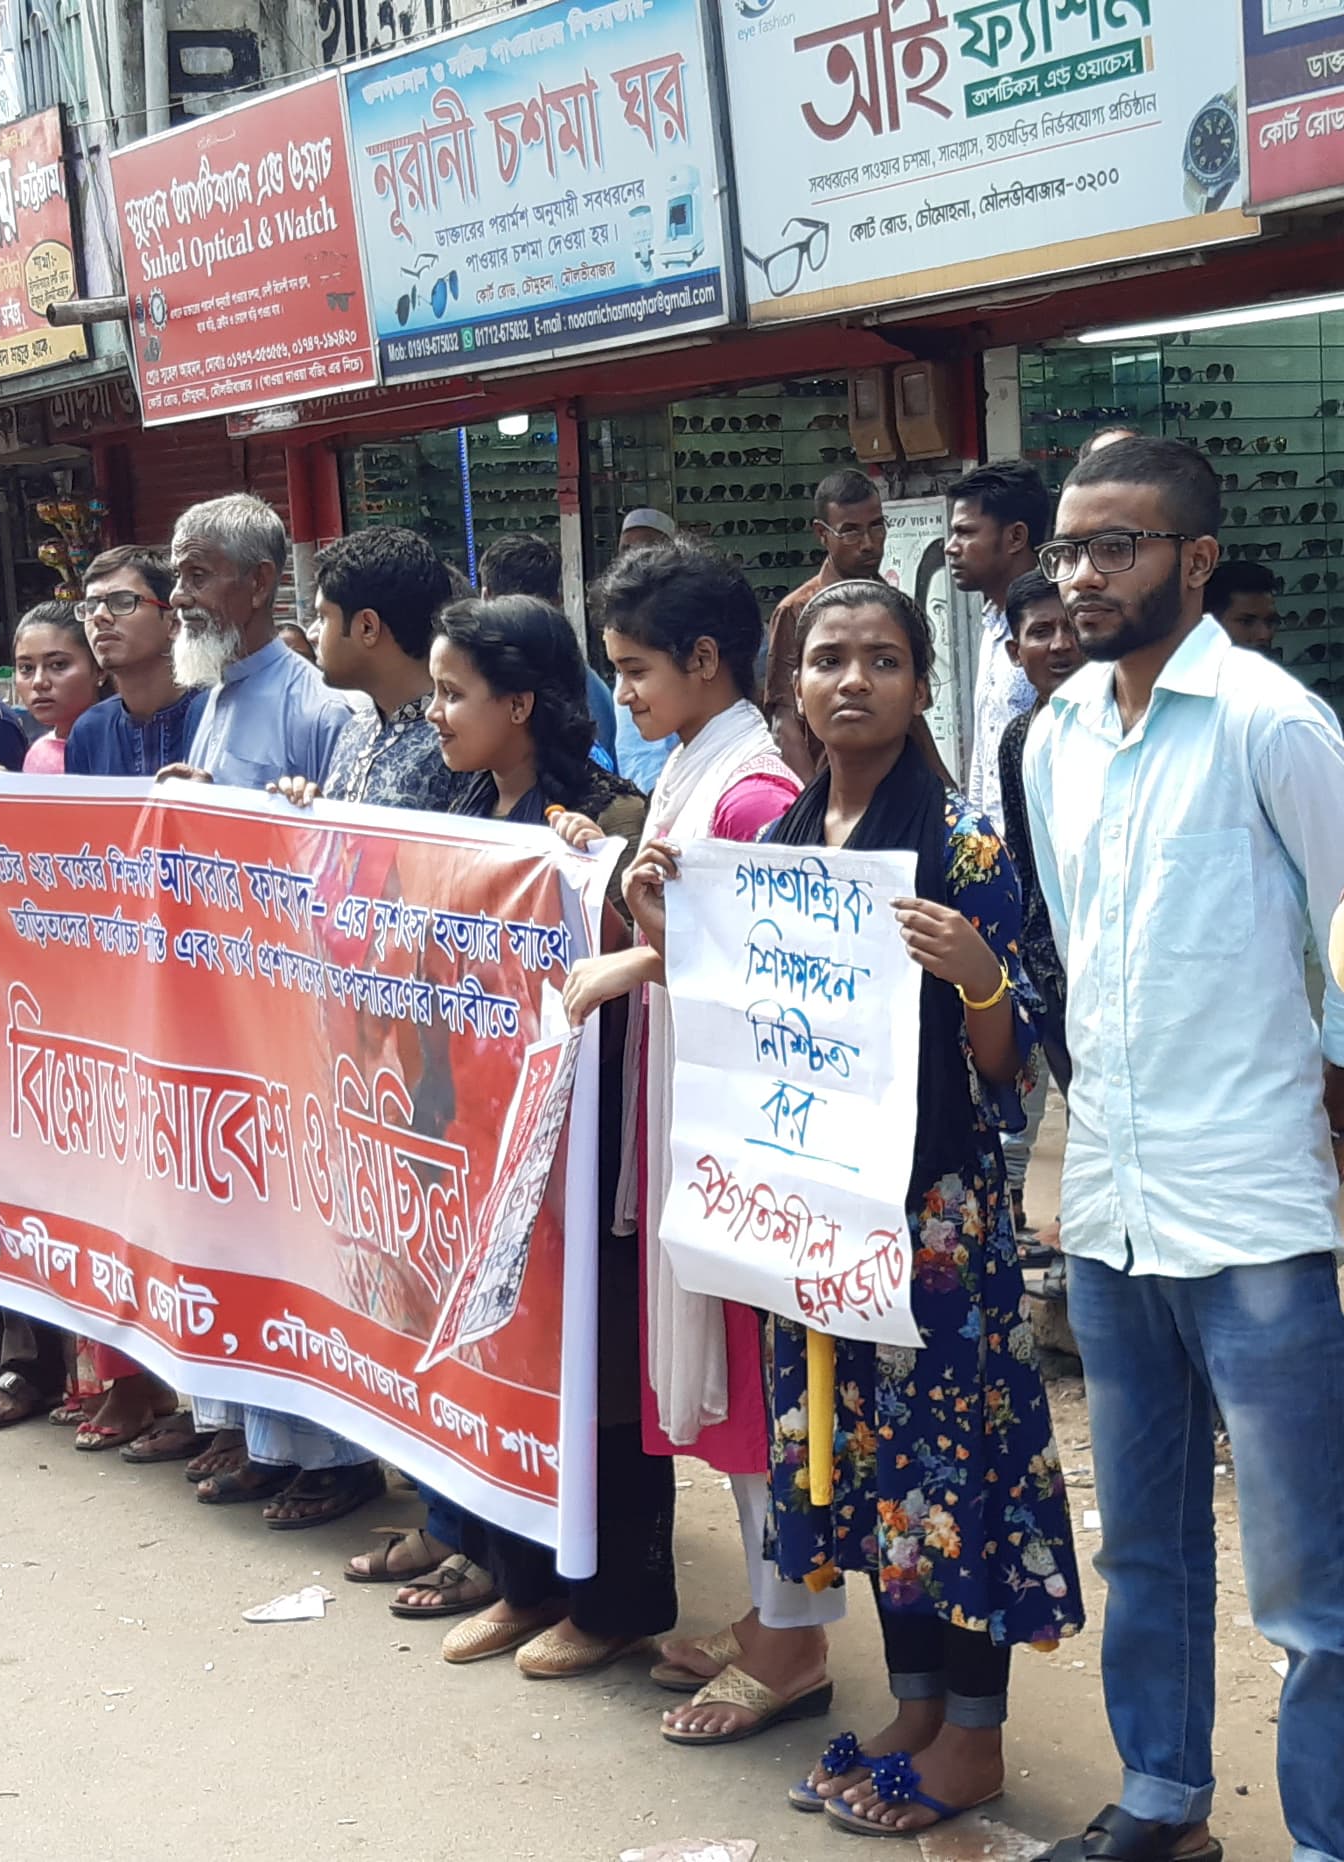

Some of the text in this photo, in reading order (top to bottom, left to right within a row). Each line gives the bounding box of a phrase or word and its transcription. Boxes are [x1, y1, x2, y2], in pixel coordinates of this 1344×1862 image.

[737, 12, 796, 41] eye fashion
[793, 0, 954, 141] আই
[365, 52, 687, 241] নূরানী চশমা ঘর
[808, 91, 1158, 194] সবধরনের পাওয়ার চশমা, সানগ্লাস, হাতঘড়ির নির্ভরযোগ্য প্রতিষ্ঠান
[1259, 110, 1300, 150] কোর্ট
[141, 195, 338, 282] Suhel Optical & Watch
[435, 217, 485, 248] ডাক্তারের
[531, 190, 579, 230] অনুযায়ী
[465, 223, 609, 274] পাওয়ার চশমা দেওয়া হয়
[849, 166, 1120, 243] কোর্ট রোড, চৌমোহনা, মৌলভীবাজার-৩২০০
[388, 342, 407, 363] Mob:
[408, 332, 459, 358] 01919-675032
[29, 854, 56, 891] ২য়
[56, 842, 106, 891] বর্ষের
[157, 846, 244, 913] আবরার
[336, 894, 369, 941] এর
[374, 897, 430, 962] নৃশংস
[433, 909, 501, 966] হত্যার
[504, 916, 574, 974] সাথে
[173, 929, 224, 974] এবং
[221, 927, 256, 981] ব্যর্থ
[325, 962, 434, 1028] অপসারণের
[436, 974, 521, 1040] দাবীতে
[760, 1079, 827, 1148] কর
[302, 1092, 336, 1226] ও
[335, 1053, 475, 1303] মিছিল
[688, 1153, 842, 1270] প্রগতিশীল
[87, 1248, 140, 1311] ছাত্র
[260, 1307, 422, 1418] মৌলভীবাজার
[428, 1389, 491, 1458] জেলা
[495, 1422, 561, 1478] শাখ
